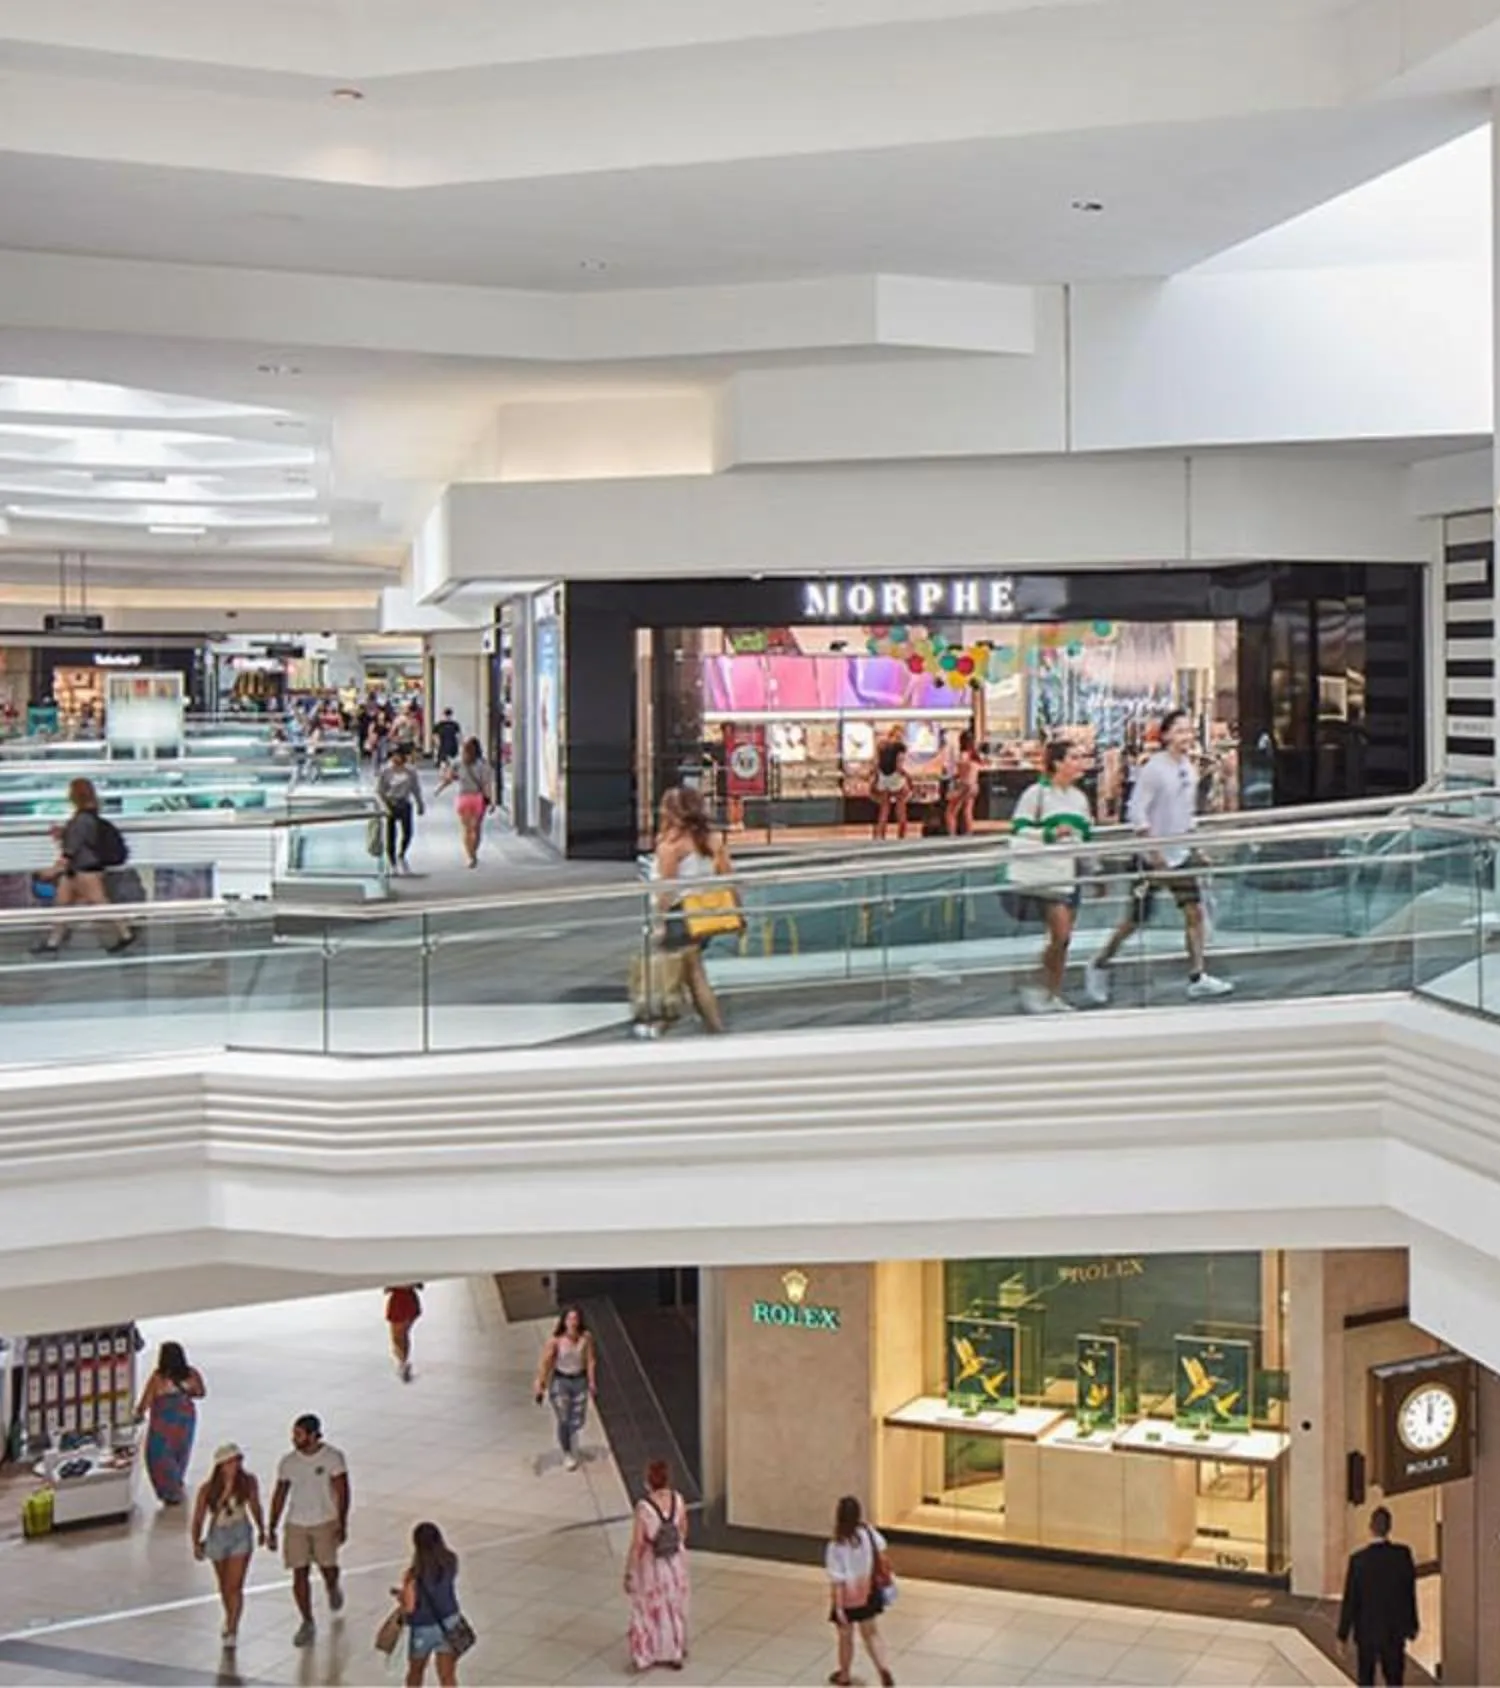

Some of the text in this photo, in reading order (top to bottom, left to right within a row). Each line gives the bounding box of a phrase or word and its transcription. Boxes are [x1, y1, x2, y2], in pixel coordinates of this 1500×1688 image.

[804, 580, 1014, 616] MORPHE
[1069, 1258, 1144, 1283] ROLEX
[752, 1302, 841, 1331] ROLEX
